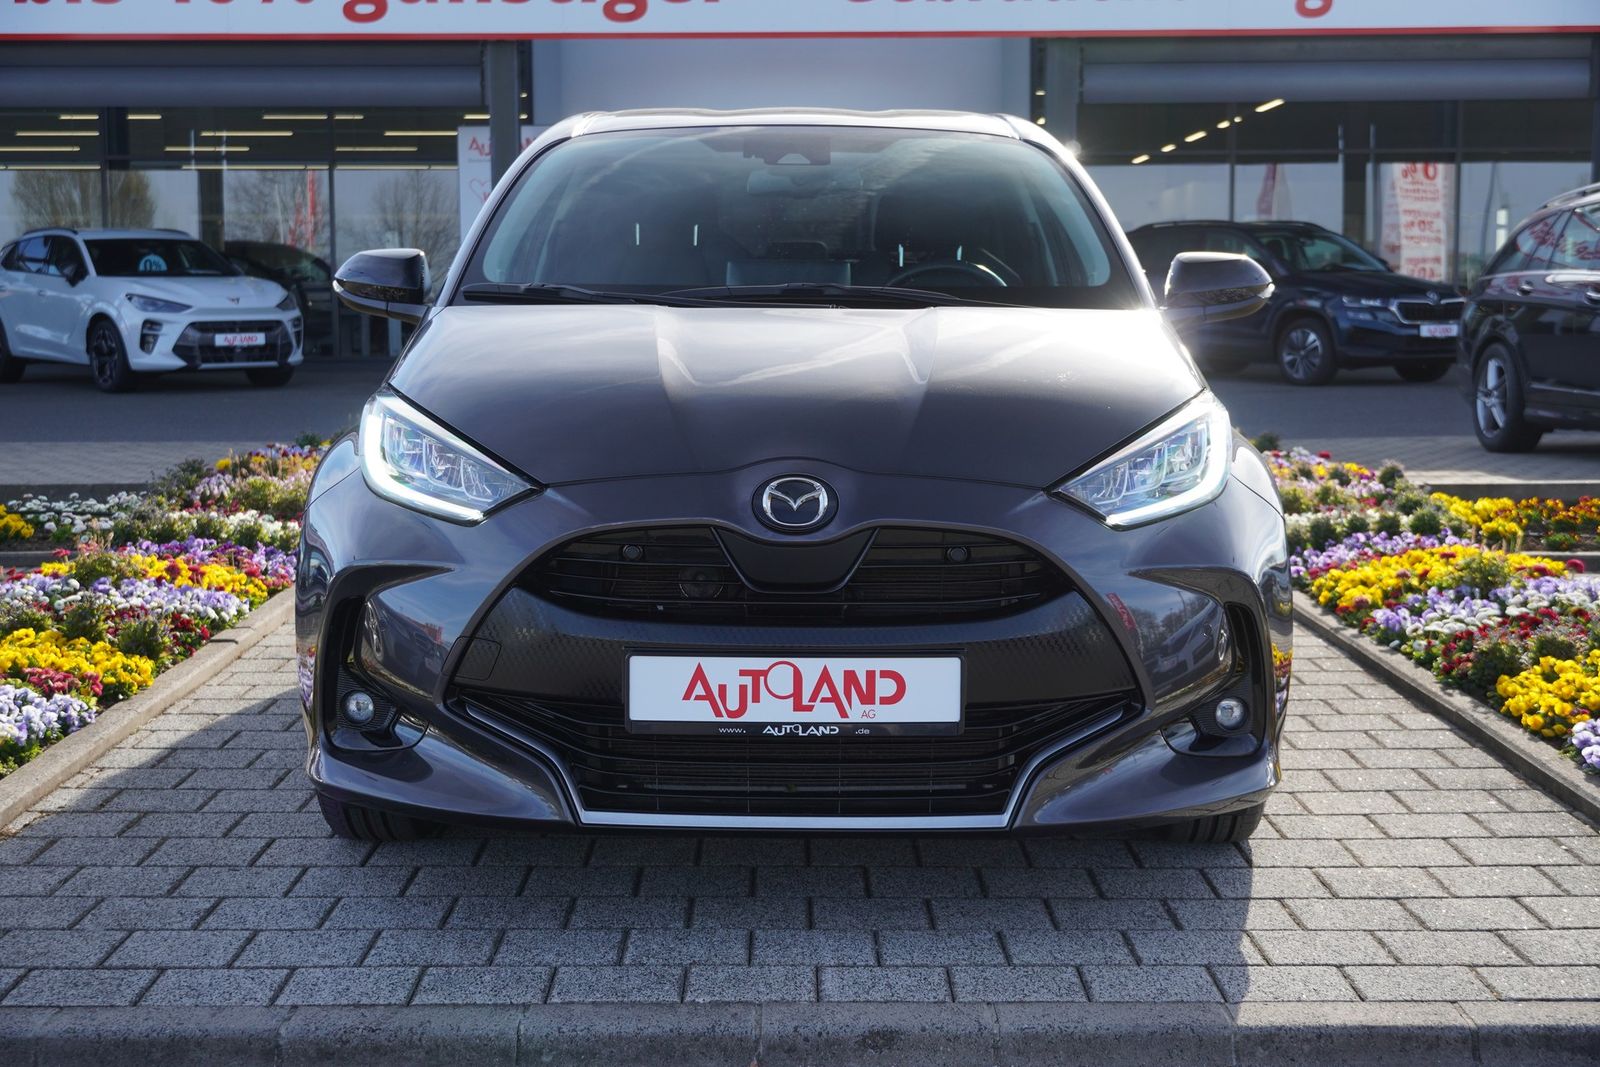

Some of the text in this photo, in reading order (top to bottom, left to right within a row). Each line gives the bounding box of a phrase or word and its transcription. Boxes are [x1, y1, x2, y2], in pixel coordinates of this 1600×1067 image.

[224, 335, 258, 346] AUTLAND
[682, 660, 907, 719] AUTOLAND
[861, 709, 876, 719] AG
[762, 725, 839, 736] AUTOLAND
